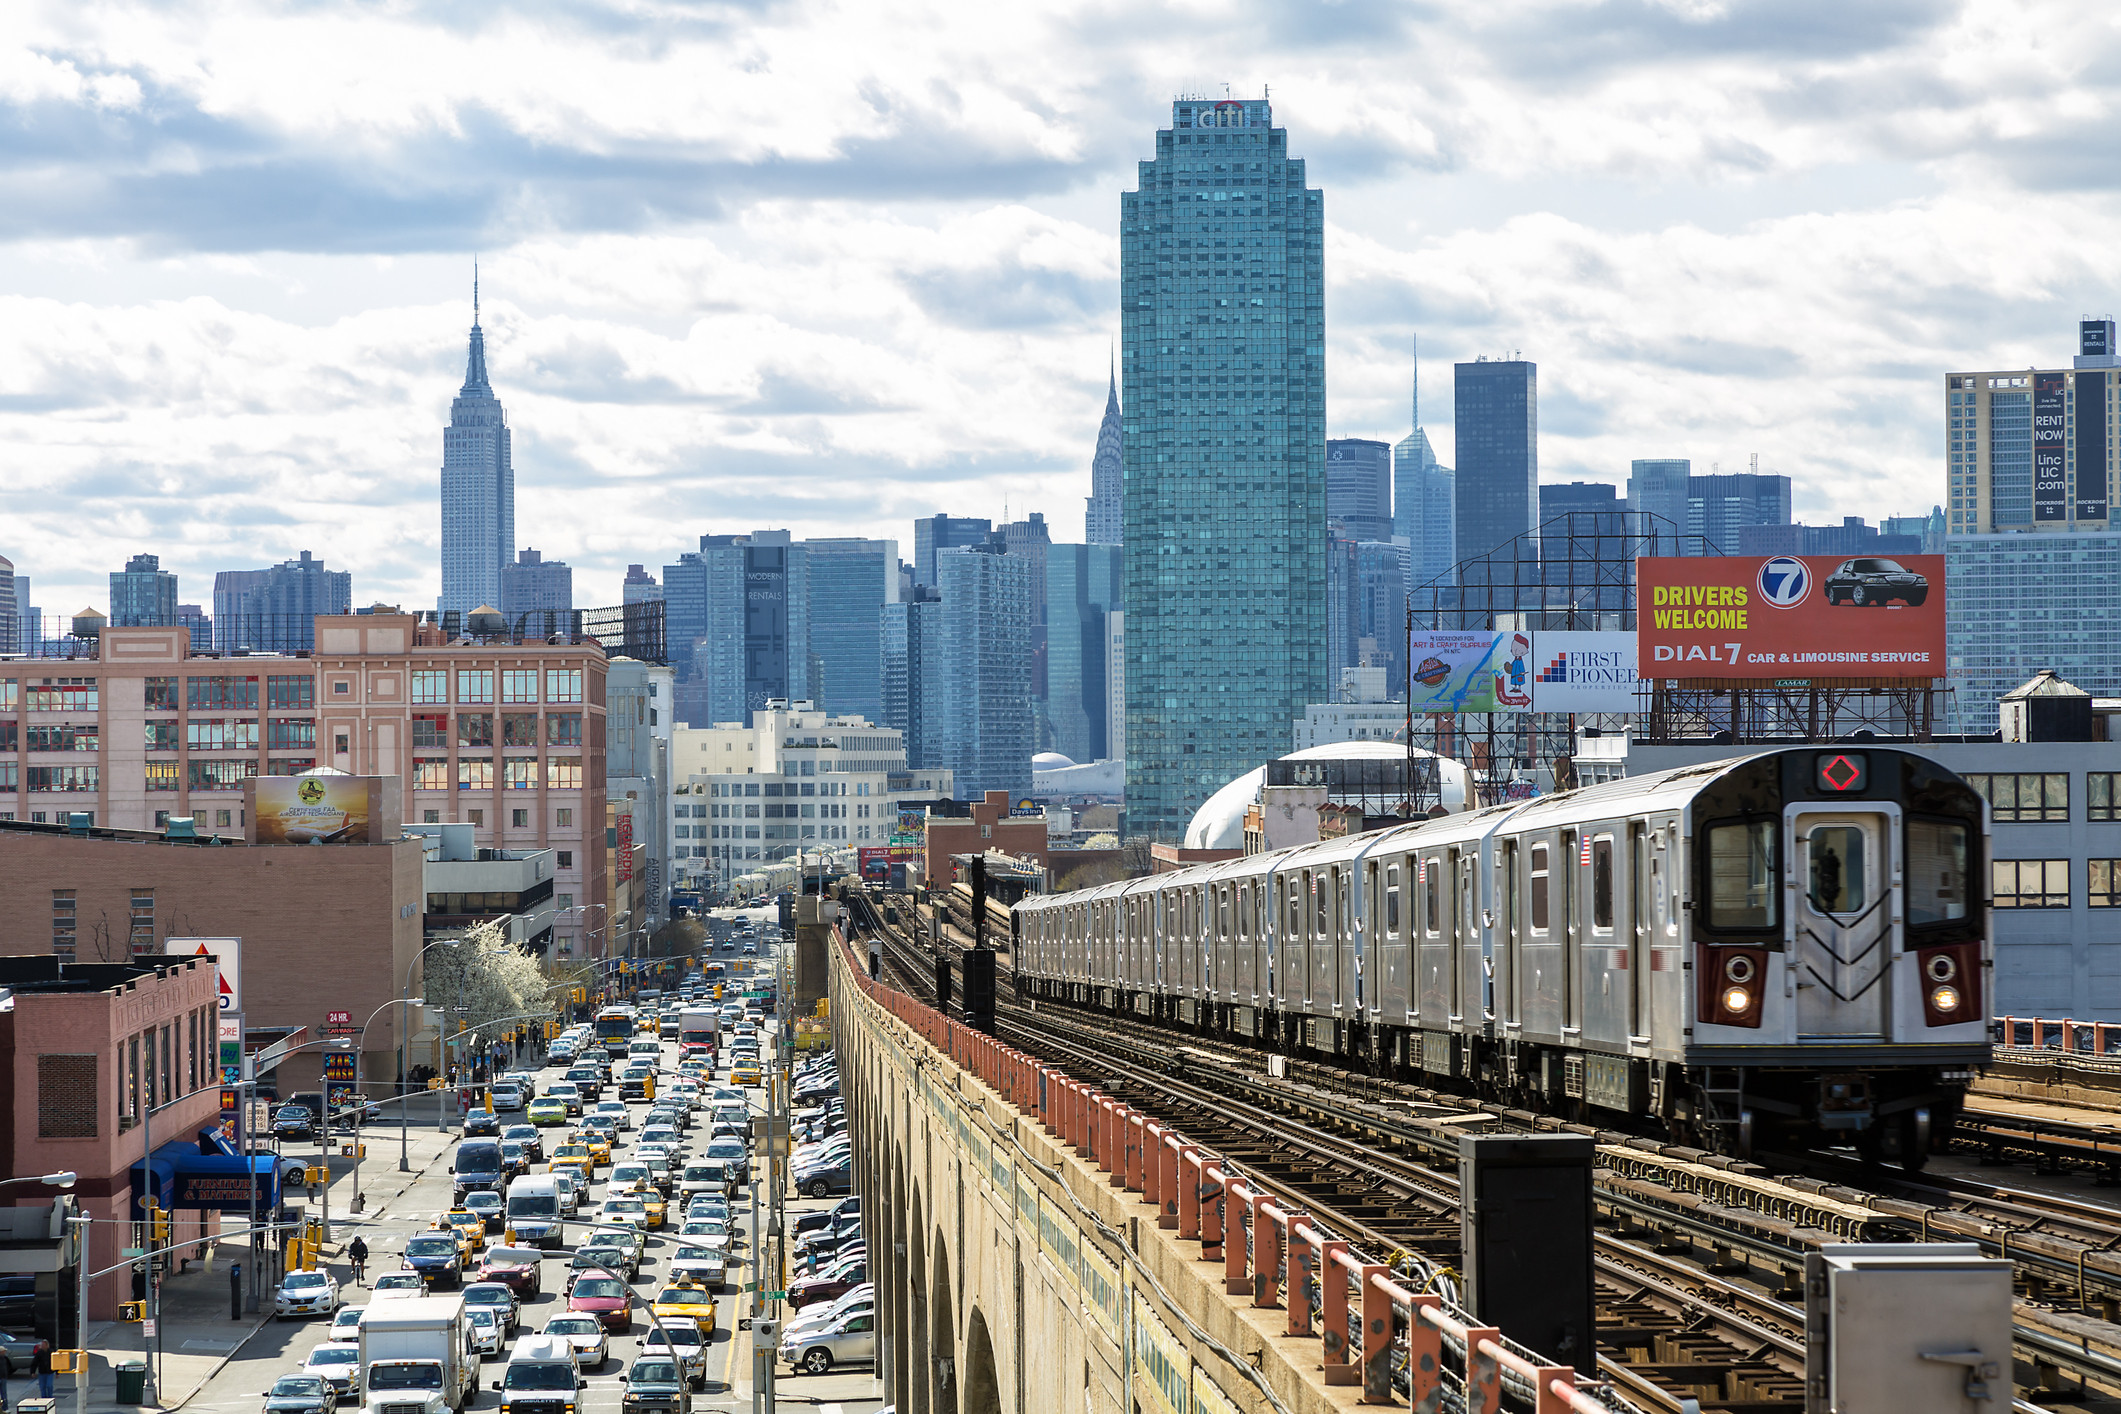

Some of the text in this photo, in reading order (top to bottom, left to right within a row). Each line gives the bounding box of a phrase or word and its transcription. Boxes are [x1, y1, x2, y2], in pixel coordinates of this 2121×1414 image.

[1199, 103, 1243, 128] citi
[2035, 415, 2063, 426] RENT
[2035, 430, 2064, 441] NOW
[2038, 454, 2061, 465] Linc
[2041, 467, 2059, 478] LIC
[2035, 481, 2065, 490] .com
[748, 572, 783, 581] MODERN
[1768, 563, 1801, 605] 7
[748, 591, 782, 600] RENTALS
[1653, 586, 1748, 606] DRIVERS
[1653, 609, 1748, 629] WELCOME
[1569, 652, 1622, 667] FIRST
[1747, 653, 1775, 663] CAR
[1779, 653, 1790, 663] &
[1793, 652, 1868, 663] LIMOUSINE
[1871, 652, 1930, 662] SERVICE
[1569, 668, 1650, 683] PIONEE
[330, 1013, 338, 1022] 24
[330, 1055, 350, 1067] CAR
[326, 1068, 354, 1080] WASH
[188, 1178, 258, 1190] FURNITUR
[183, 1190, 195, 1200] &
